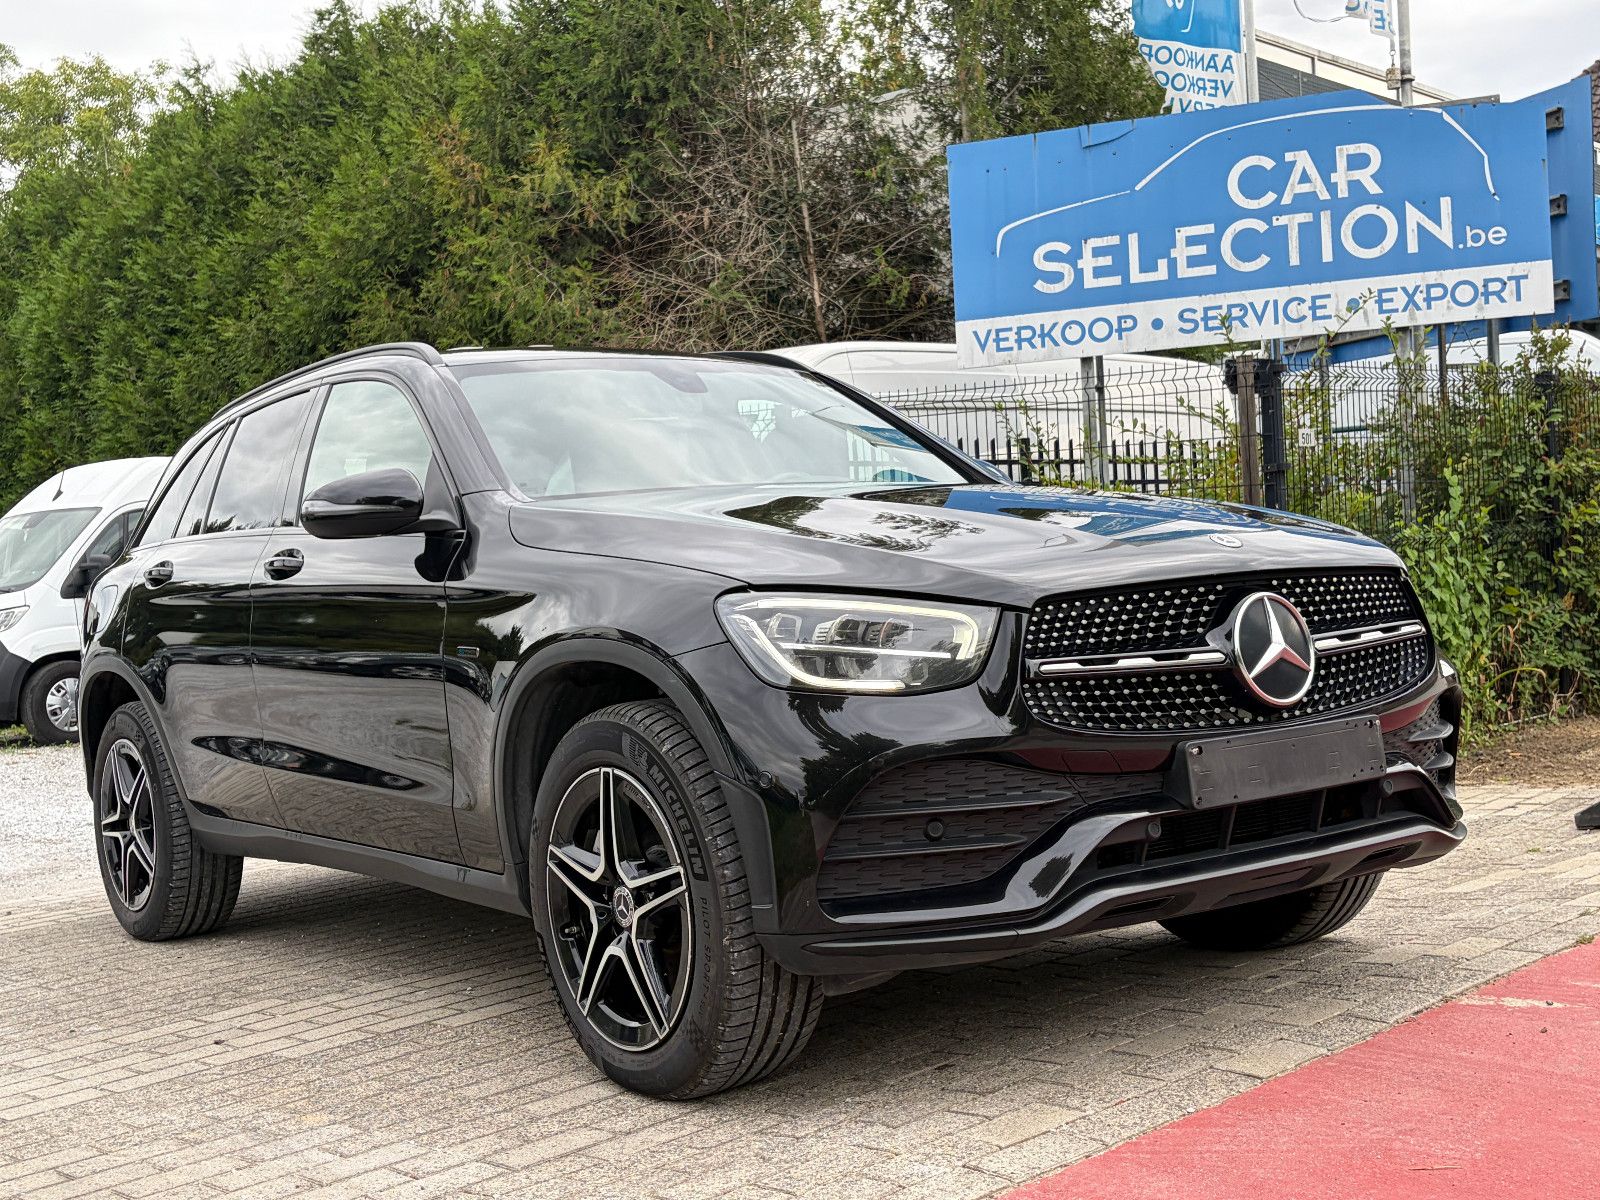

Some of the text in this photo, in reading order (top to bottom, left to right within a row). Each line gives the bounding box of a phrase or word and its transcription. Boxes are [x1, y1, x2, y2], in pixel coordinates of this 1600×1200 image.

[1226, 141, 1384, 210] CAR
[972, 274, 1529, 355] VERKOOP SERVICE EXPORT
[1301, 432, 1312, 445] 501
[649, 763, 705, 876] MICHELIN
[699, 896, 711, 940] PILOT
